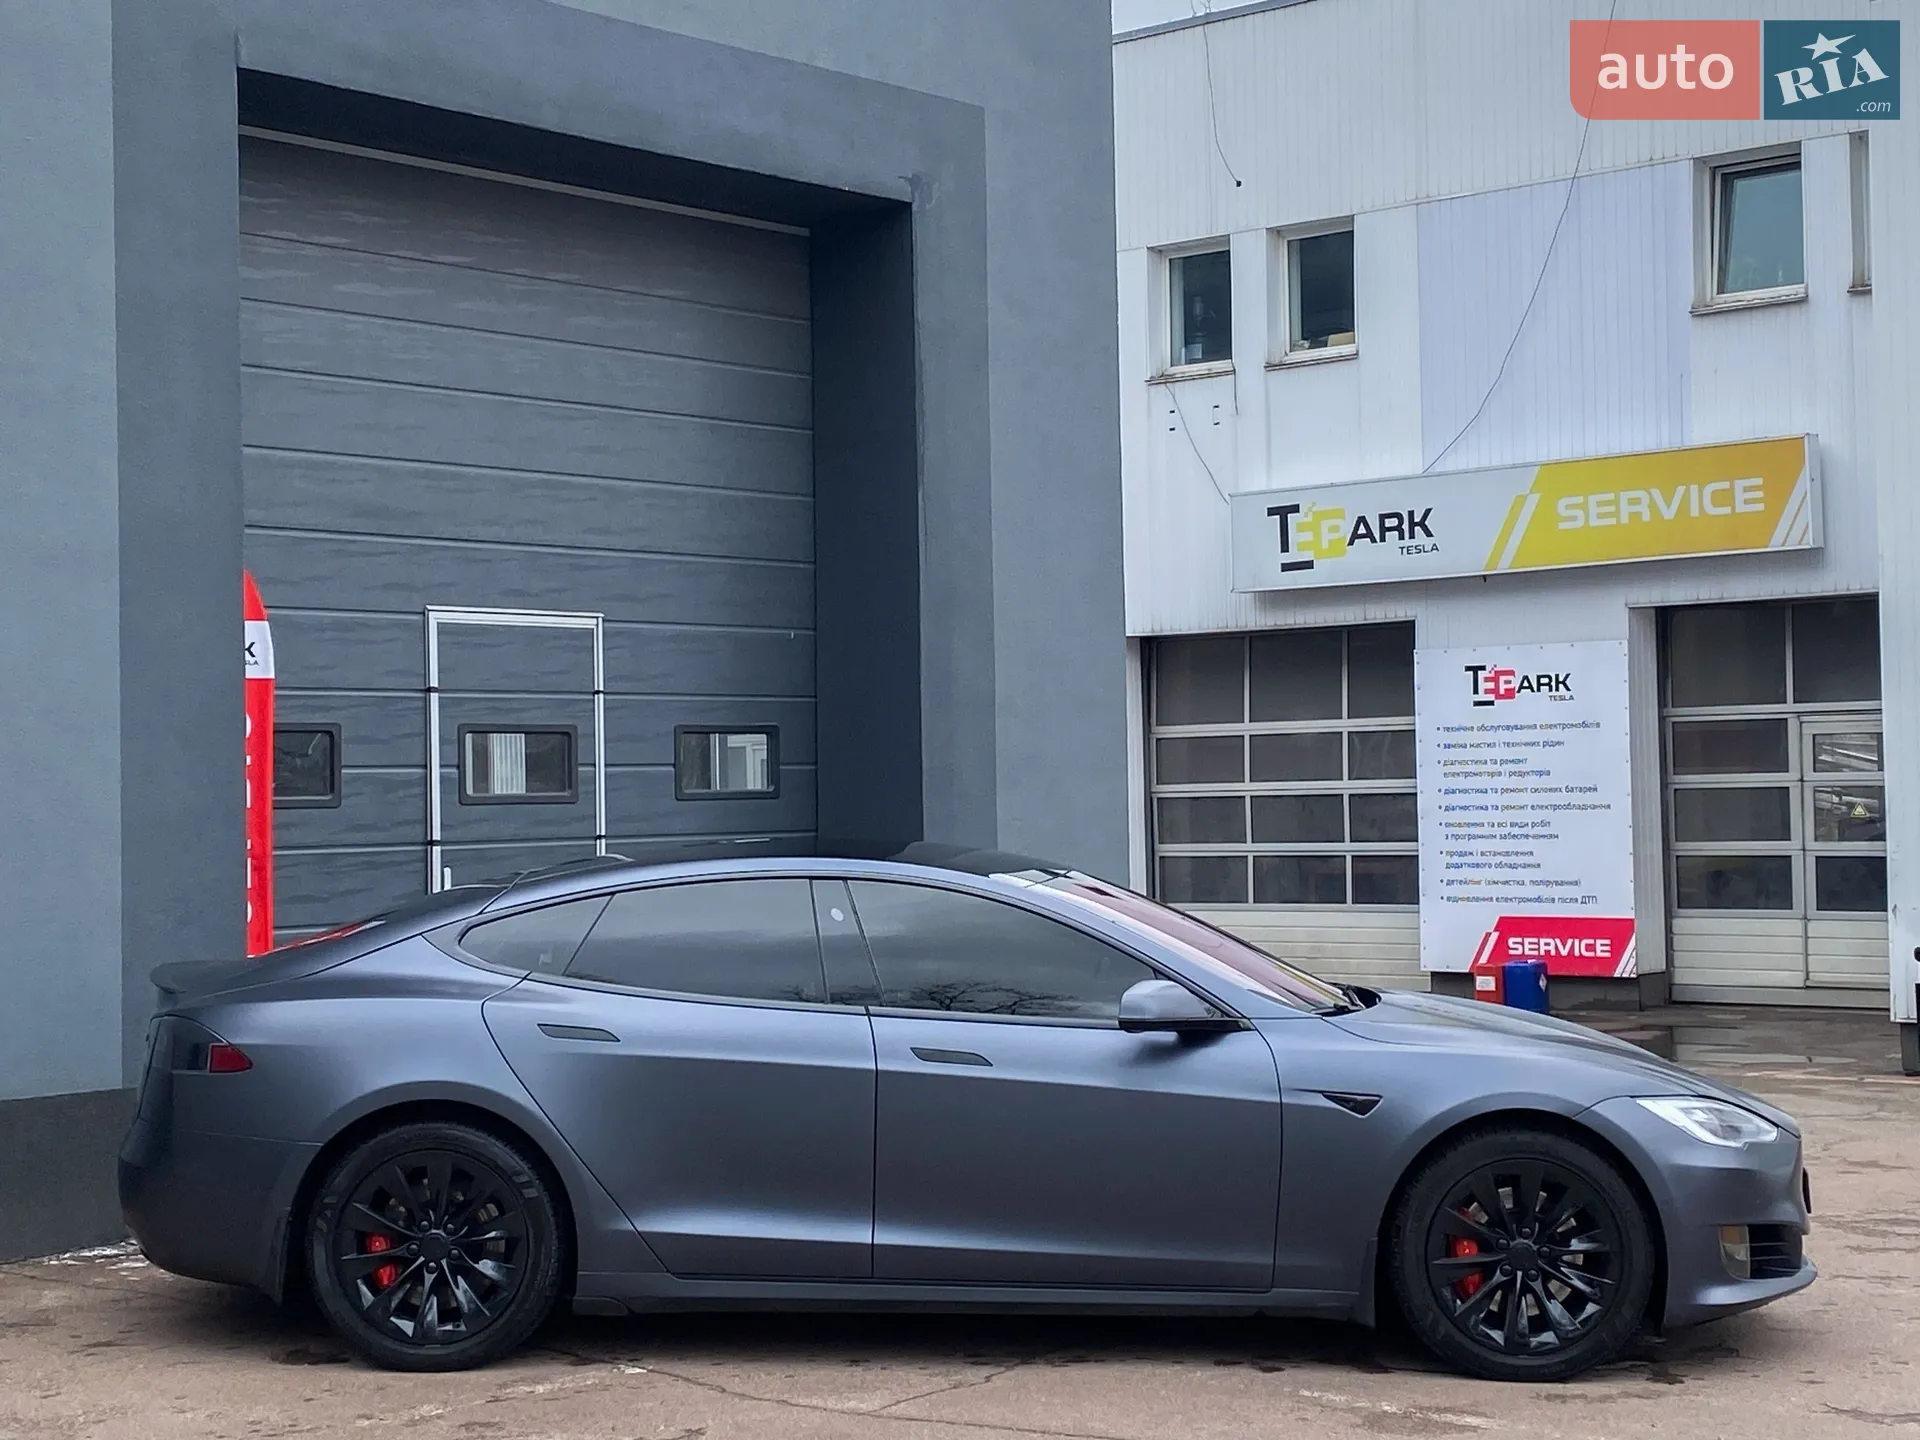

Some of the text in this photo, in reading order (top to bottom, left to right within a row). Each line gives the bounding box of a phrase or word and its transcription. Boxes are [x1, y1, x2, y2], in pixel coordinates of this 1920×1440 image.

[1556, 477, 1765, 530] SERVICE
[1398, 543, 1440, 556] TESLA
[1542, 739, 1565, 749] рідин
[1489, 758, 1498, 766] та
[1499, 757, 1528, 767] ремонт
[1508, 768, 1551, 778] редукторів
[1444, 786, 1488, 796] діагностика
[1500, 786, 1528, 796] ремонт
[1564, 784, 1598, 794] батарей
[1444, 803, 1488, 812] діагностика
[1490, 803, 1499, 811] та
[1500, 803, 1528, 813] ремонт
[1486, 820, 1495, 828] та
[1531, 819, 1551, 829] робіт
[1445, 849, 1474, 858] продаж
[1445, 861, 1492, 870] додаткового
[1495, 894, 1556, 905] електромобілів
[1580, 895, 1598, 905] ДТП
[1507, 937, 1612, 958] SERVICE
